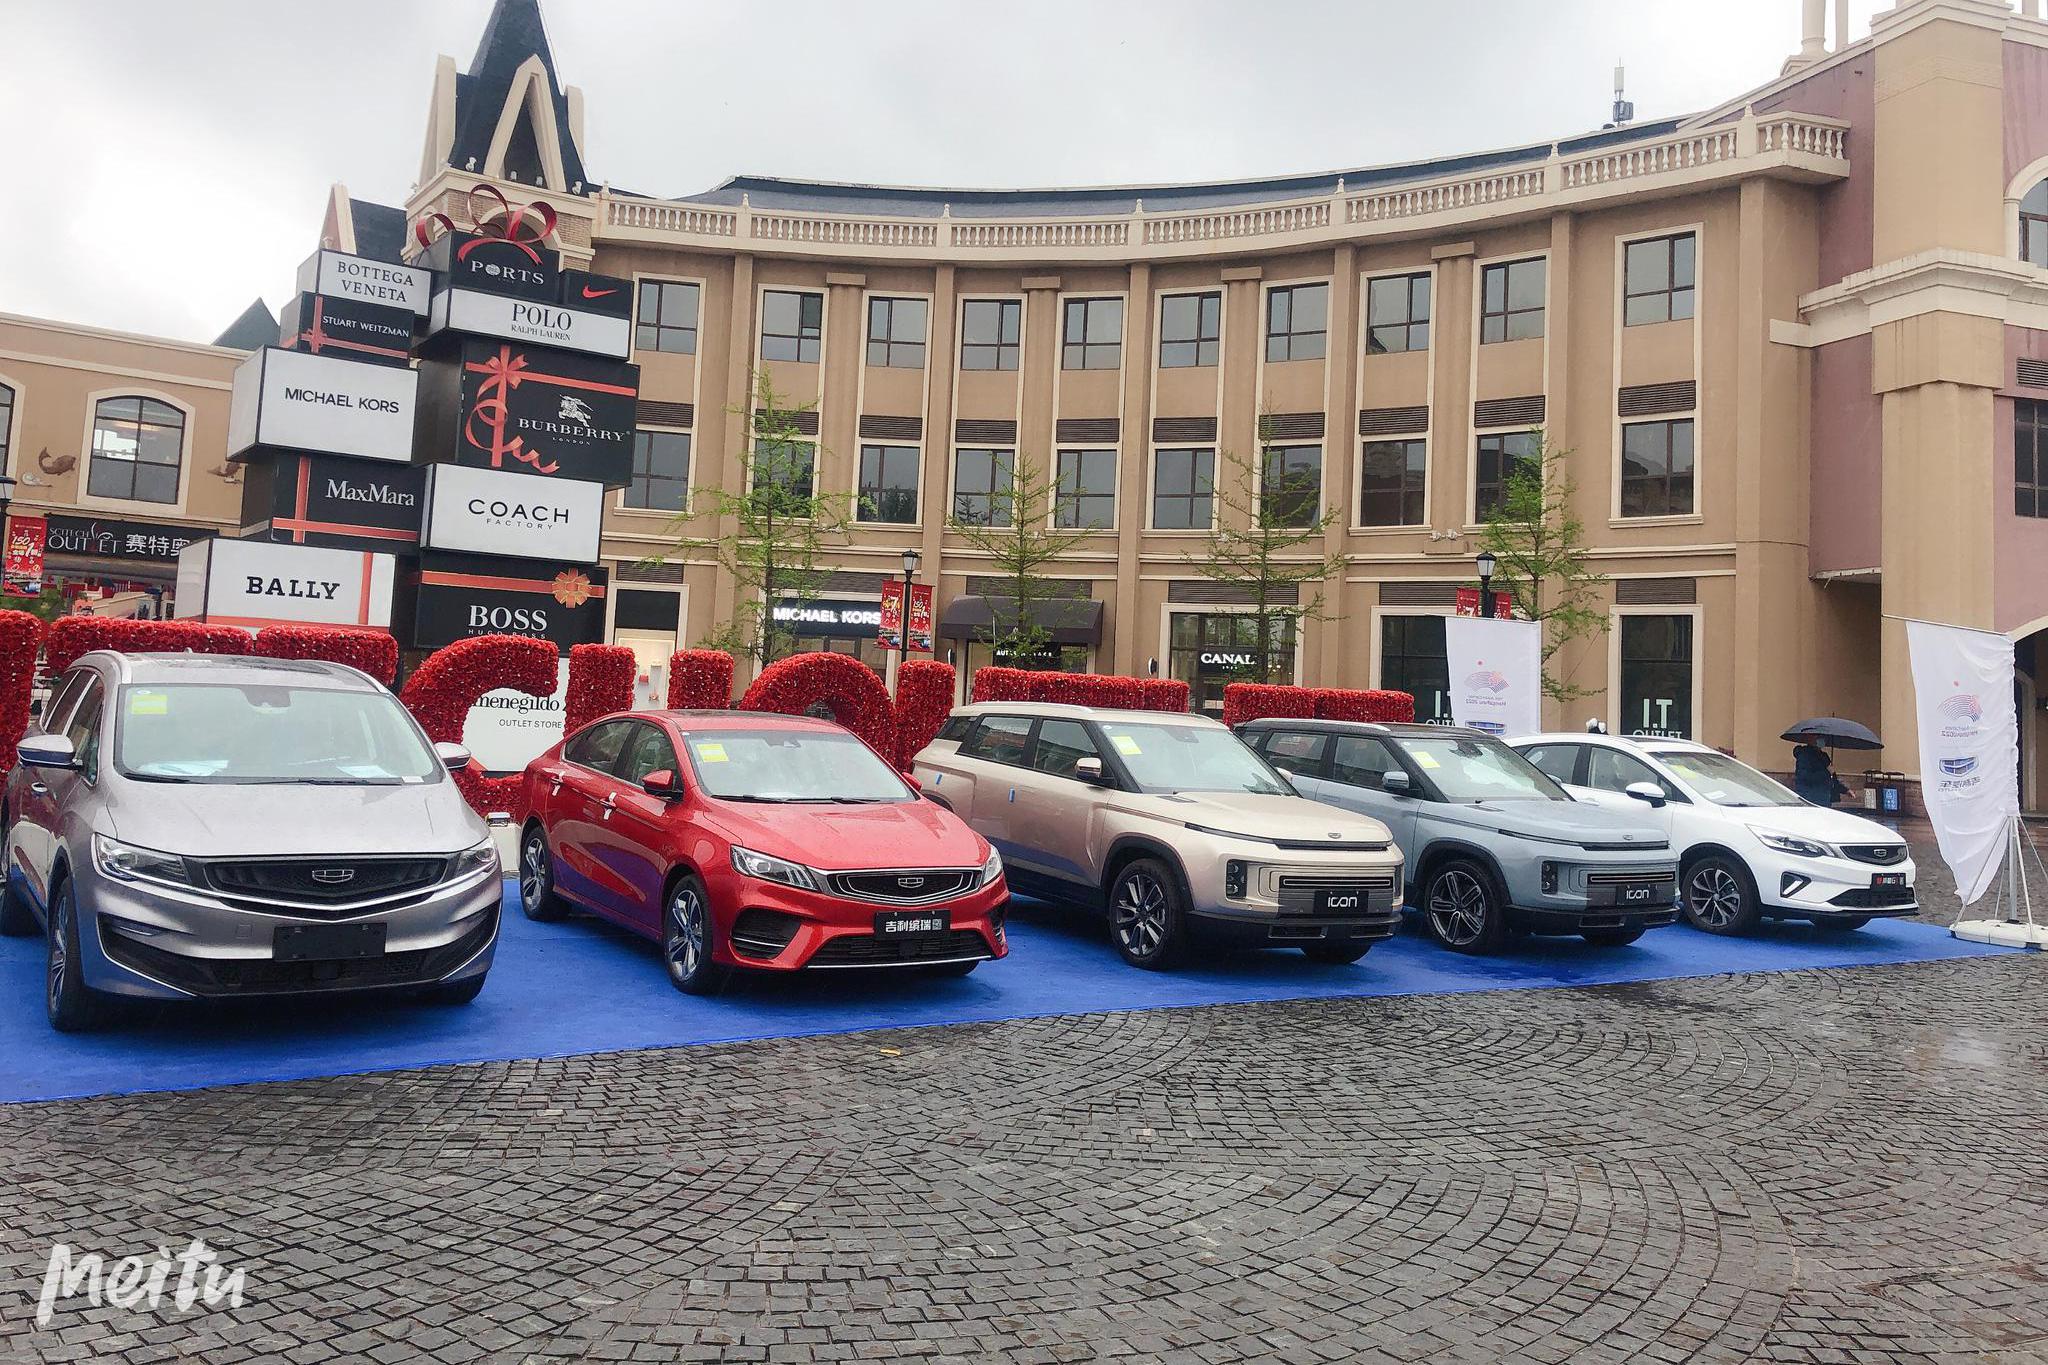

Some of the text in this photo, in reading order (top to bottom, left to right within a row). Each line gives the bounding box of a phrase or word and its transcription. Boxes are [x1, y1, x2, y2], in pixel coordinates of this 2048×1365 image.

[337, 261, 415, 287] BOTTEGA
[342, 279, 407, 303] VENETA
[322, 315, 410, 338] STUART WEITZMAN
[512, 303, 572, 331] POLO
[511, 323, 571, 341] RALPH LAUREN
[285, 387, 400, 413] MICHAEL KORS
[518, 417, 625, 442] BURBERRY
[325, 478, 415, 506] MaxMara
[468, 499, 569, 524] COACH
[486, 518, 553, 530] FACTORY
[245, 576, 340, 600] BALLY
[468, 605, 548, 632] BOSS
[773, 607, 881, 625] MICHAEL KORS
[498, 719, 562, 729] OUTLET STORE
[1643, 698, 1673, 729] I.T
[885, 919, 931, 933] 吉利缤瑞
